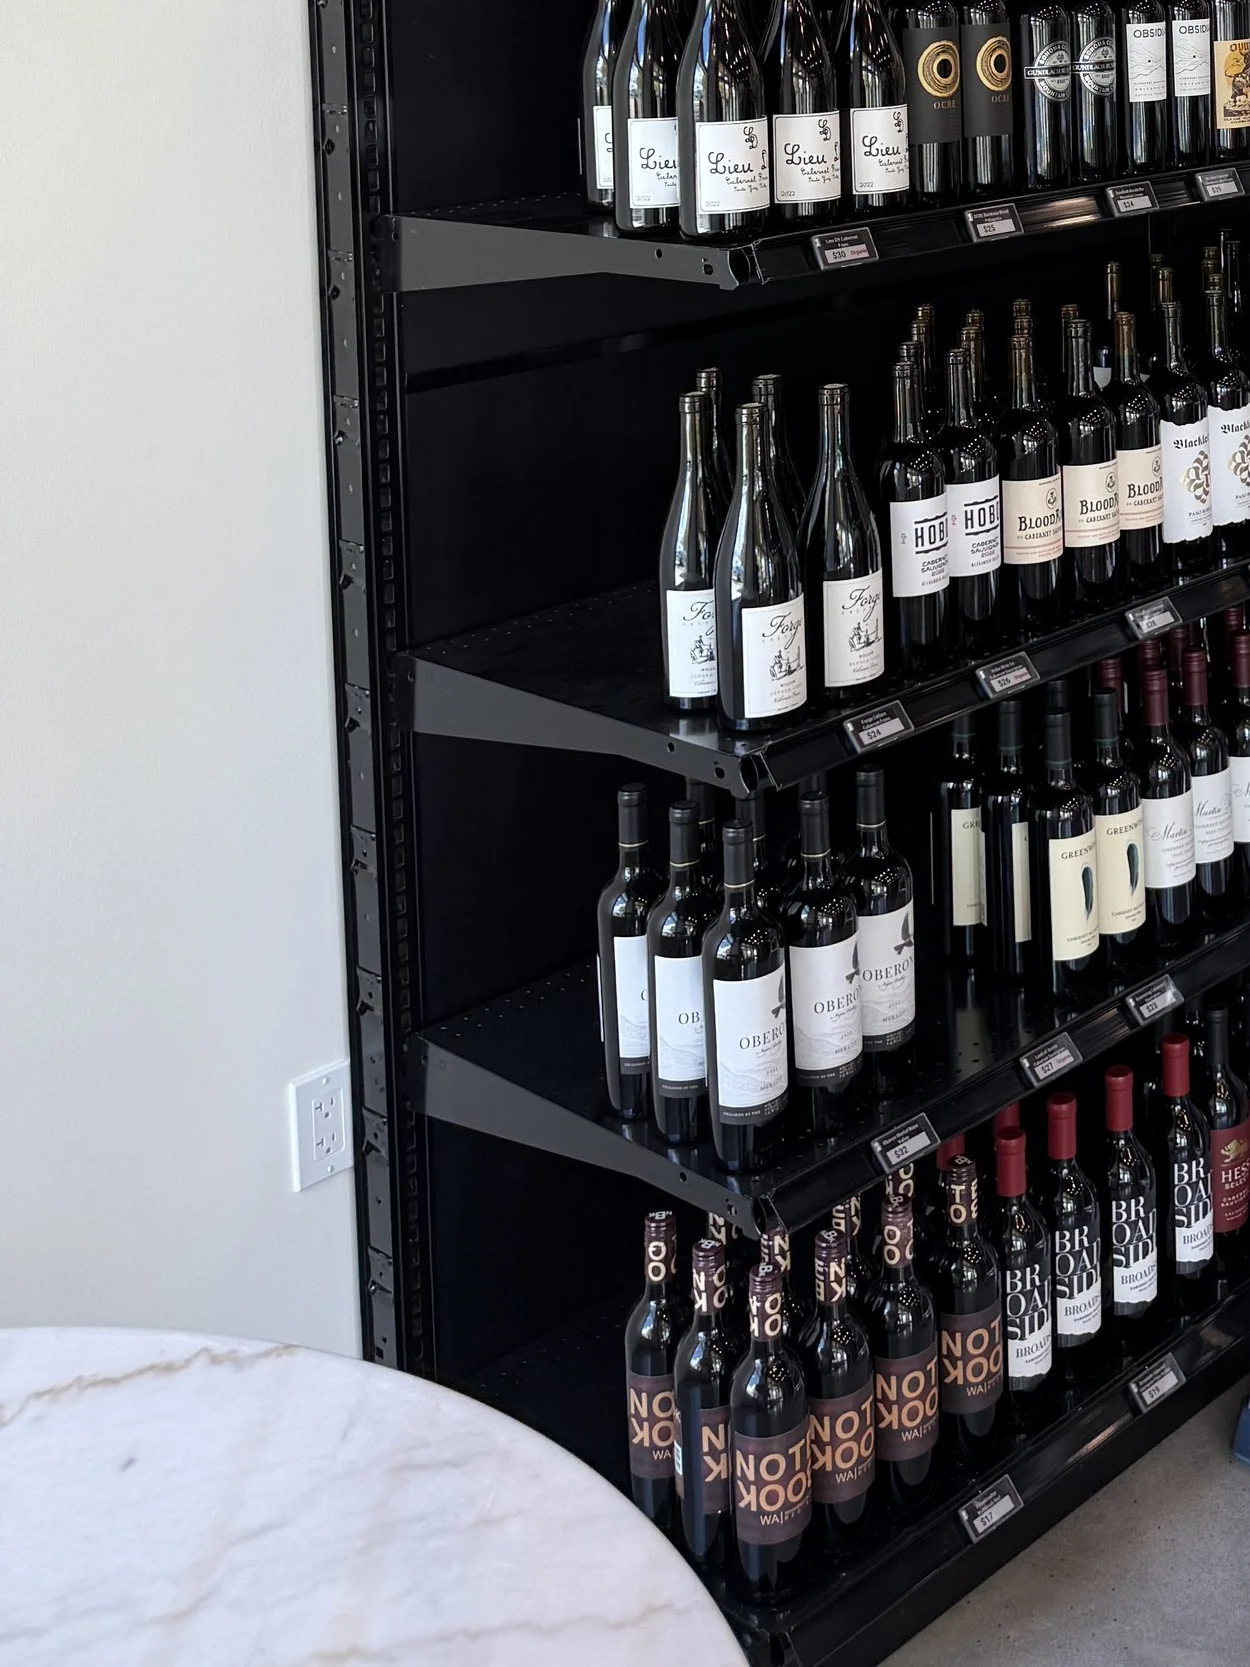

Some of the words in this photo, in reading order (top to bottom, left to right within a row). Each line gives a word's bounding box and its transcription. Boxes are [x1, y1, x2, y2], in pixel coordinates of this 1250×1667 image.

[784, 143, 827, 166] Lieu
[862, 135, 901, 157] Lieu
[708, 152, 753, 175] Lieu
[983, 224, 996, 233] $25
[833, 250, 847, 259] $30
[1042, 1063, 1054, 1074] $27
[894, 1145, 909, 1158] $32
[809, 1395, 873, 1443] NOT
[736, 1438, 806, 1481] NOT
[981, 1512, 994, 1526] $17
